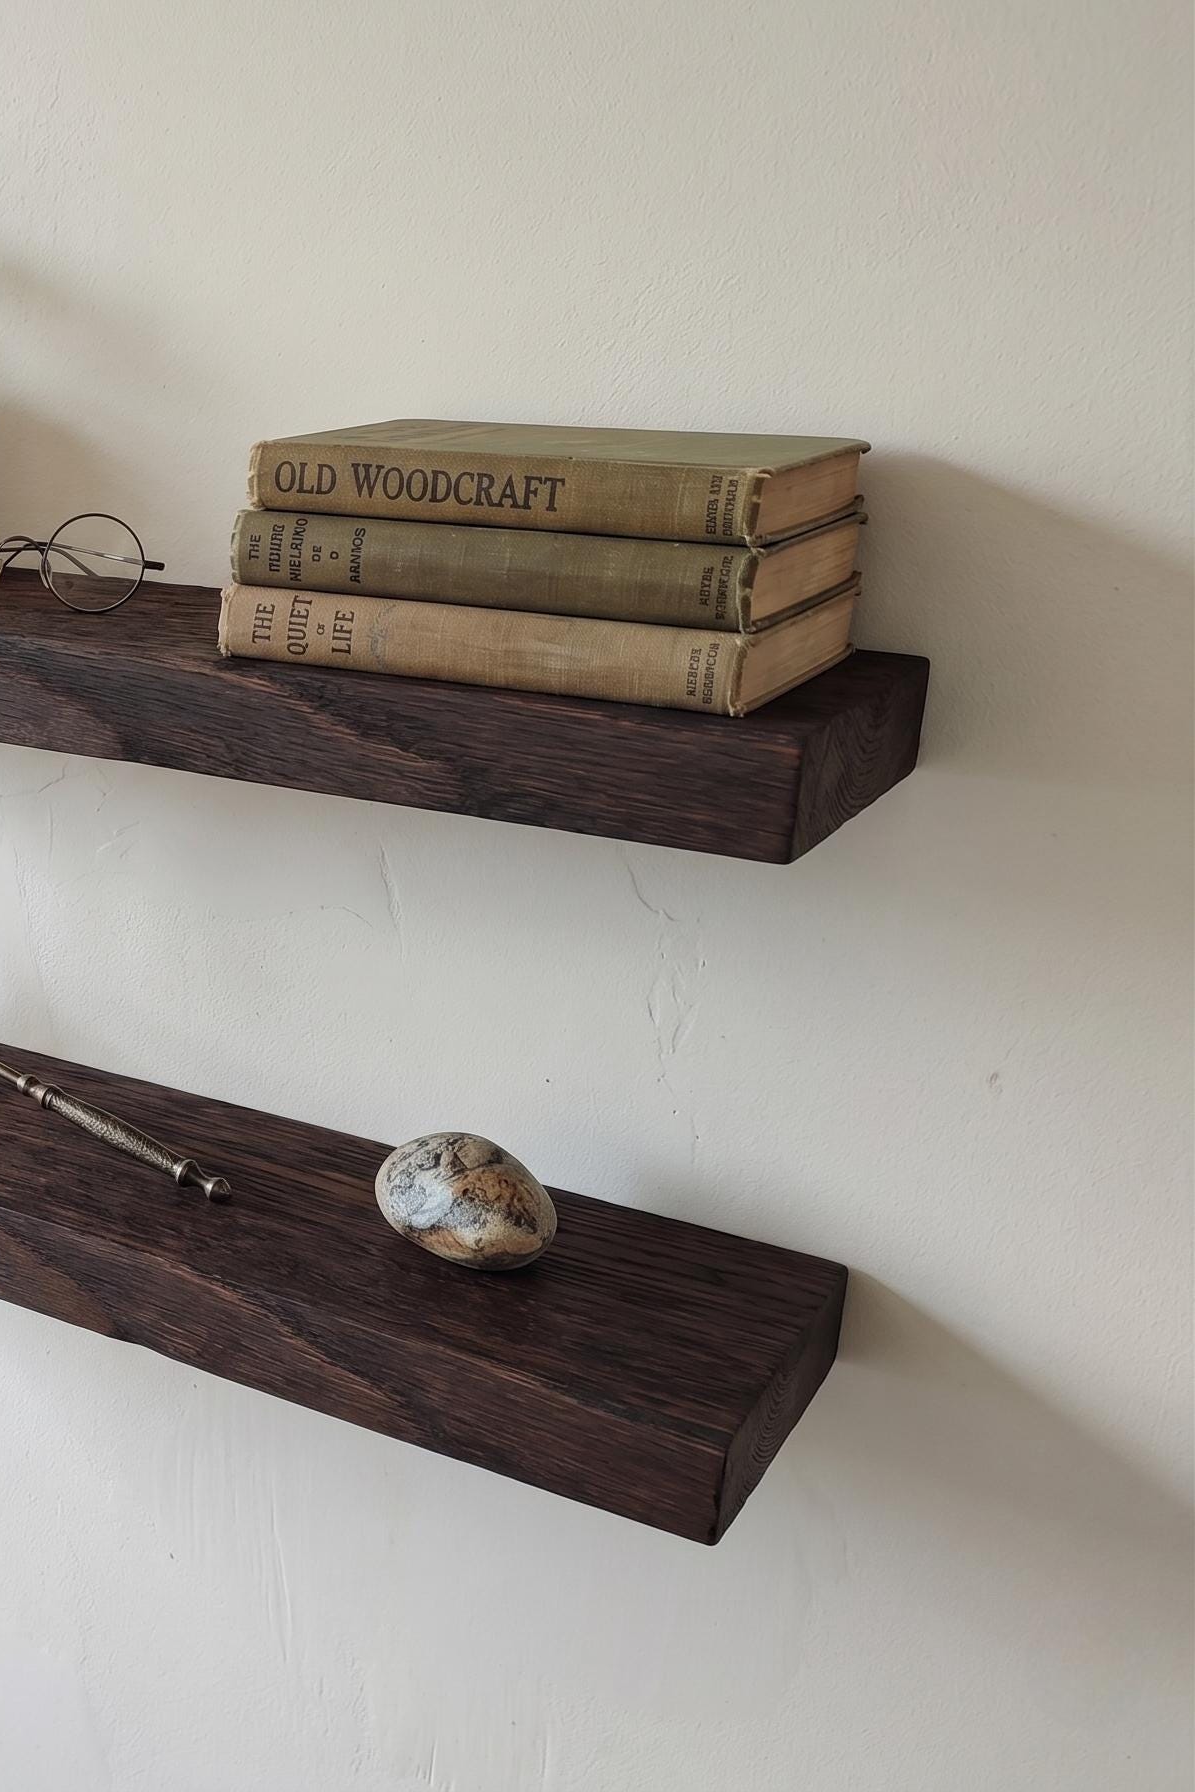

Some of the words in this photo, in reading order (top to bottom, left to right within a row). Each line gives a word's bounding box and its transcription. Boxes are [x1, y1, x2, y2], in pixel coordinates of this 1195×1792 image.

[274, 461, 337, 495] OLD
[351, 462, 566, 512] WOODCRAFT
[248, 534, 262, 560] THE
[252, 602, 275, 644] THE
[287, 595, 313, 656] QUIET
[331, 610, 355, 655] LIFE
